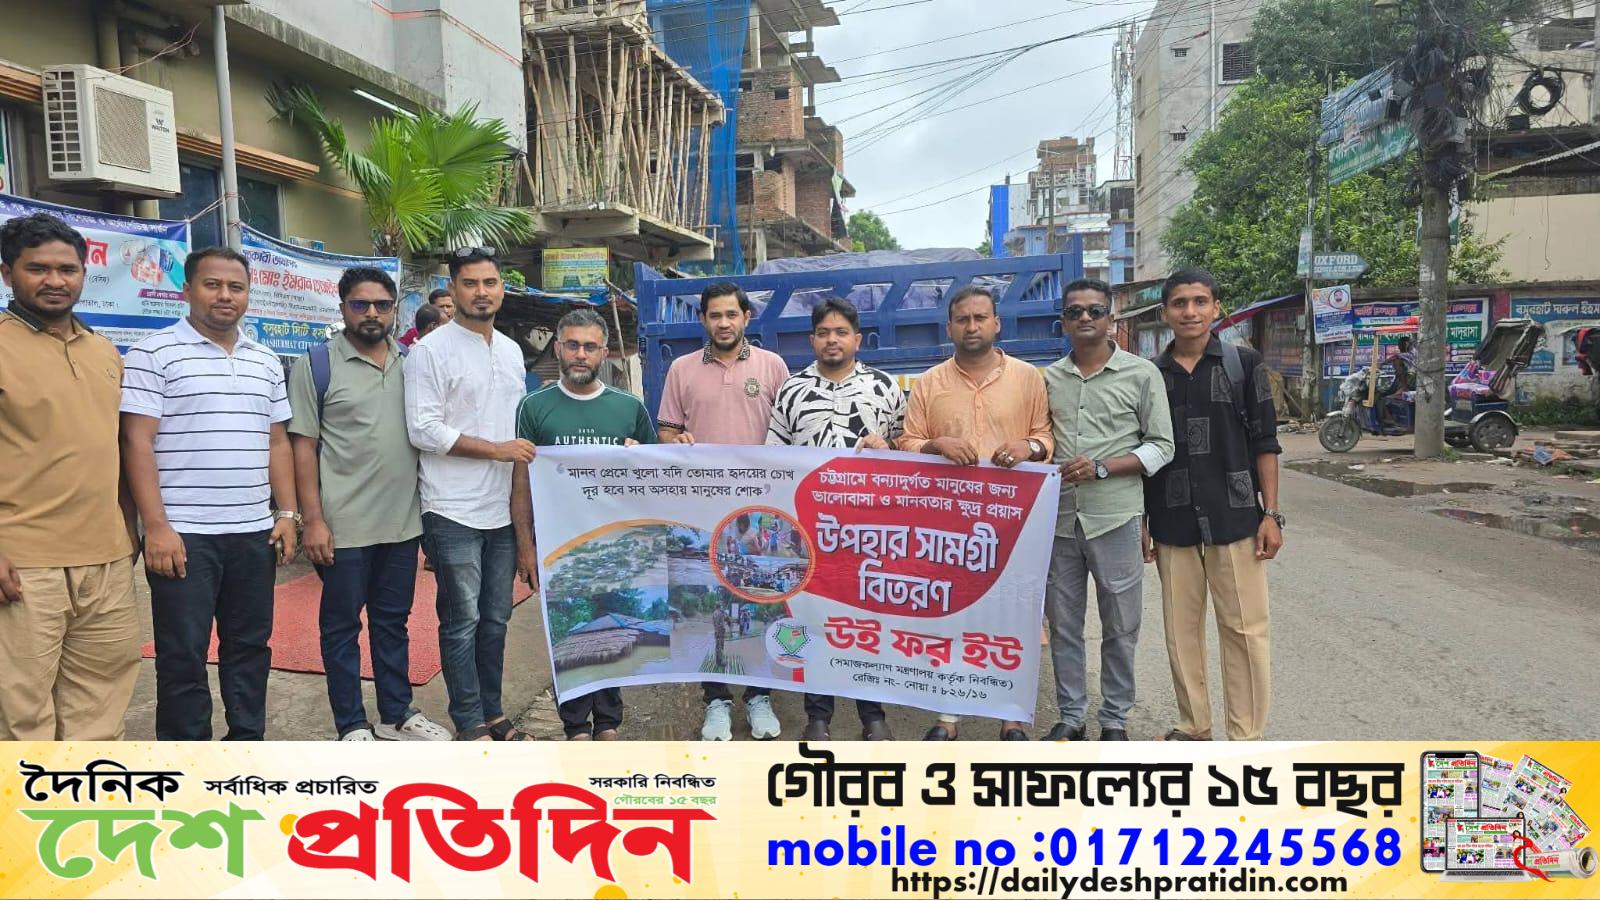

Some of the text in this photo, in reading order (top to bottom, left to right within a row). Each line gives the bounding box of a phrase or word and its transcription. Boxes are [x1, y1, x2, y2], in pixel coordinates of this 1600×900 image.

[1314, 255, 1358, 266] OXFORD
[555, 436, 619, 446] AUTHENTIC
[601, 468, 629, 479] প্রেমে
[632, 468, 659, 481] খুলো
[663, 466, 682, 480] যদি
[687, 469, 724, 480] তোমার
[729, 469, 767, 481] হৃদয়ের
[771, 471, 796, 482] চোখ
[819, 470, 1019, 499] চট্টগ্রামে বন্যাদুর্গত মানুষের জন্য
[582, 486, 599, 500] দূর
[603, 485, 625, 497] হবে
[629, 486, 645, 497] সব
[650, 486, 688, 498] অসহায়
[692, 487, 731, 498] মানুষের
[811, 490, 1024, 521] ভালোবাসা ও মানবতার ক্ষুদ্র প্রয়াস
[816, 512, 1000, 574] উপহার সামগ্রী
[858, 559, 953, 613] বিতরণ
[823, 616, 1024, 671] উই ফর ইউ
